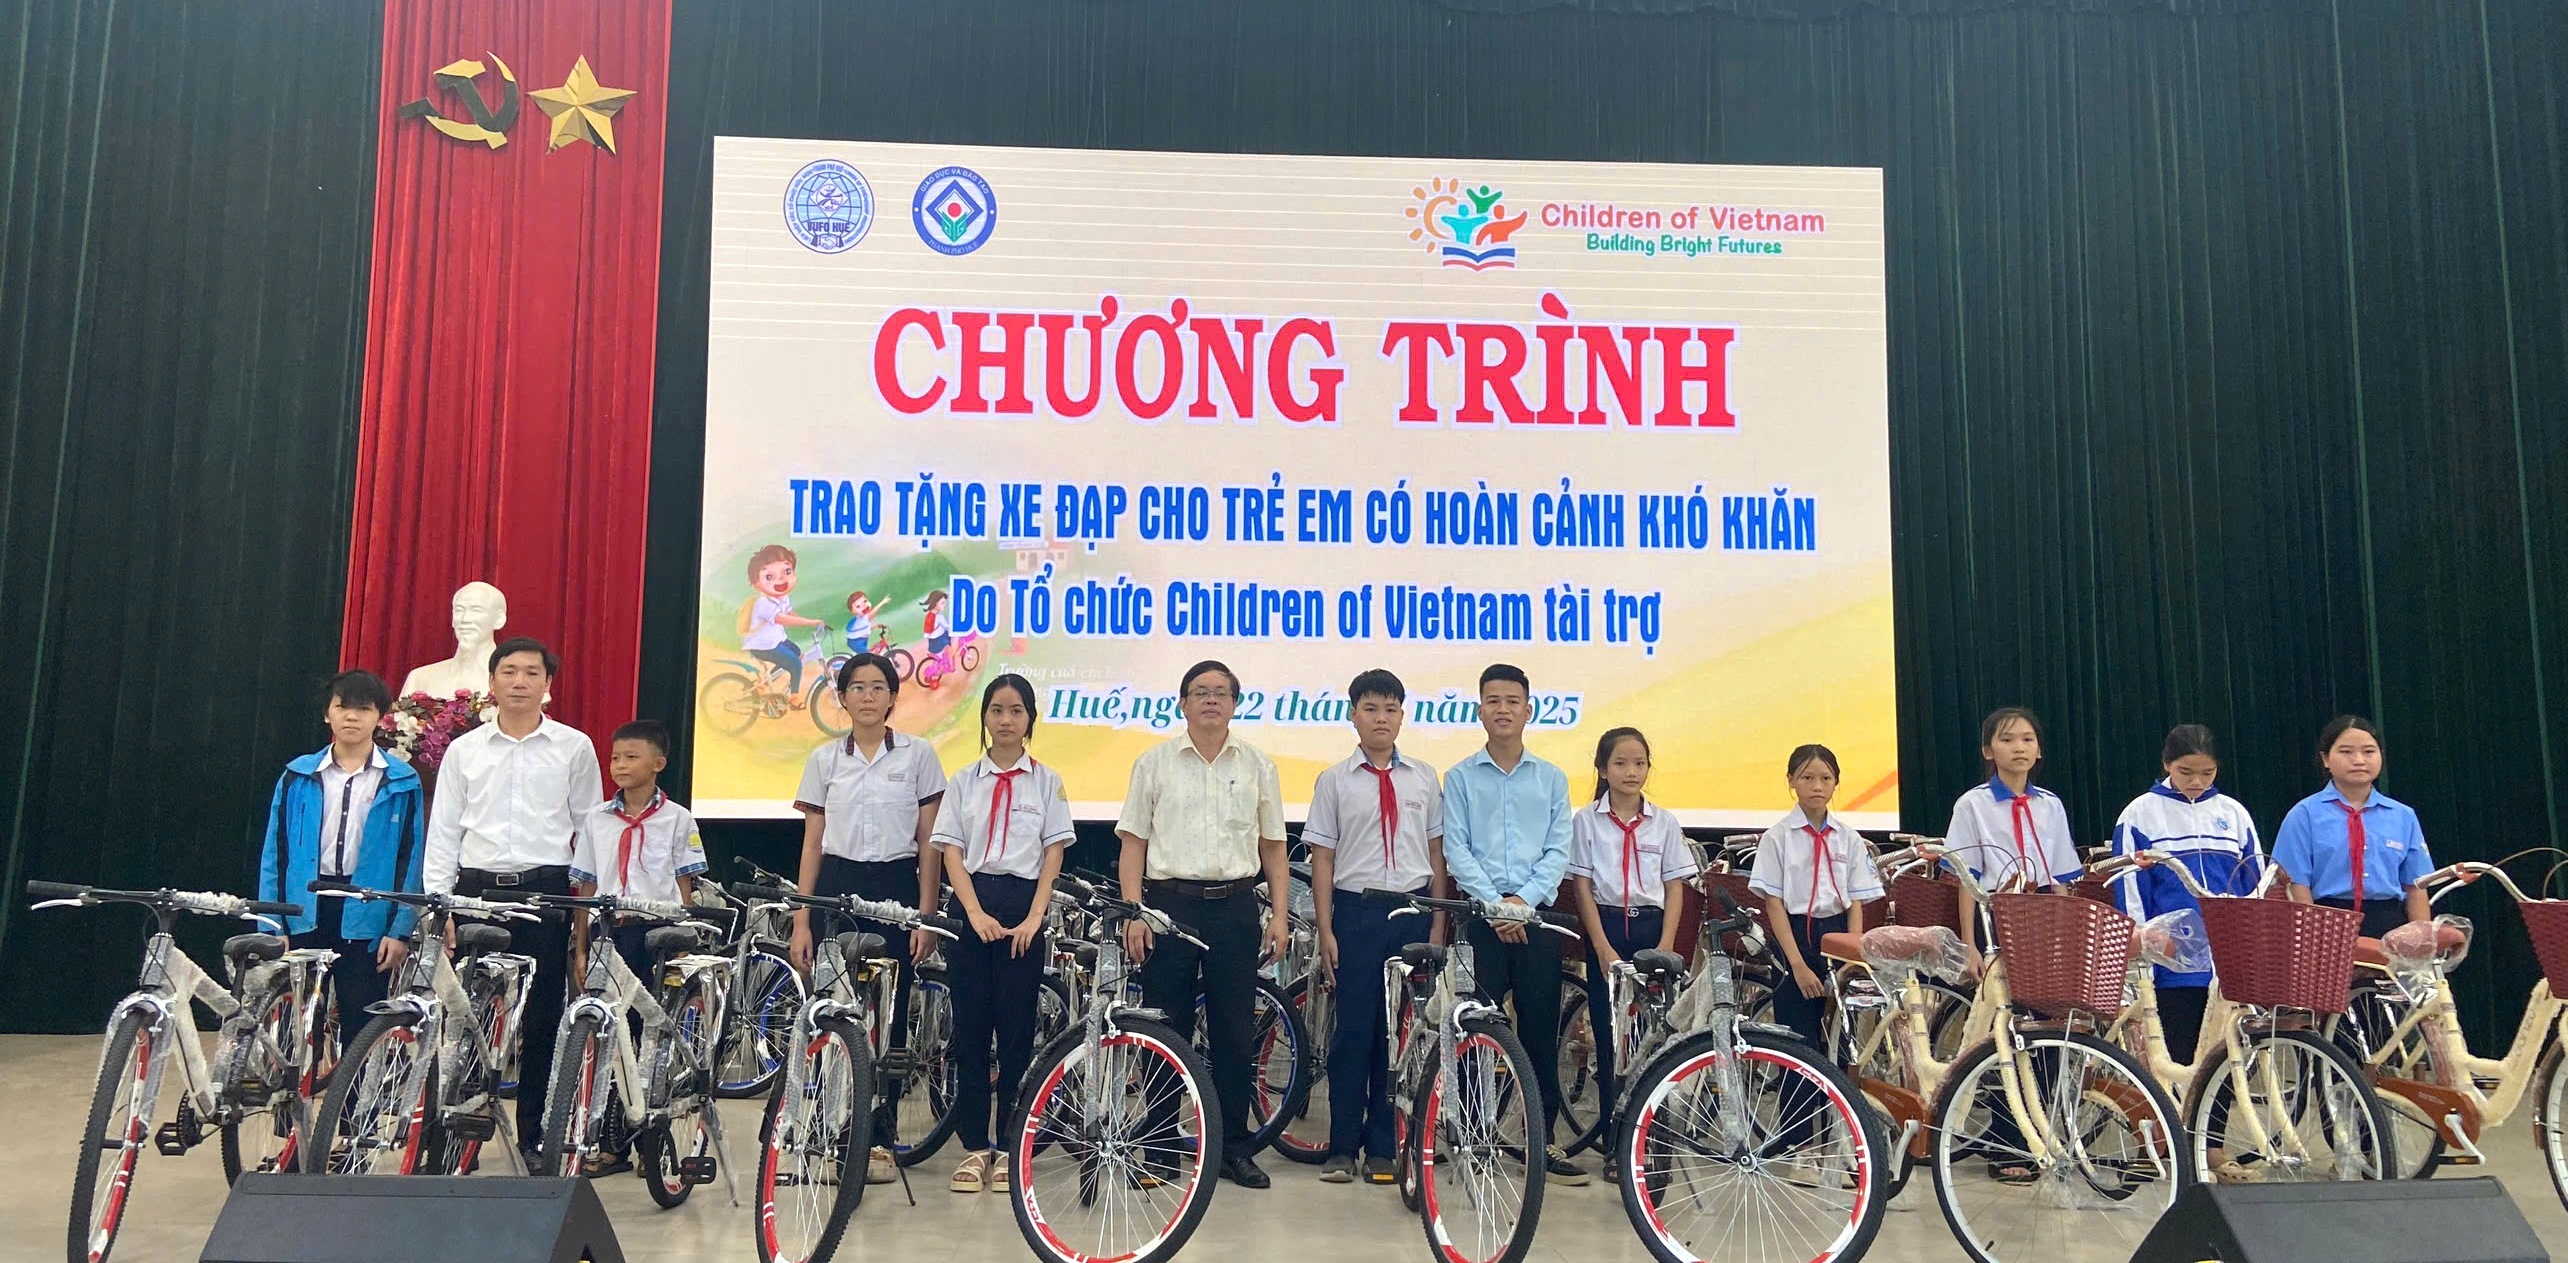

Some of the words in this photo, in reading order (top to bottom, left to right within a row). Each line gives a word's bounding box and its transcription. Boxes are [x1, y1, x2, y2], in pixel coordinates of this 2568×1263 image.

[808, 221, 830, 232] VUFO
[1542, 204, 1660, 228] Children
[1671, 207, 1698, 229] of
[1710, 208, 1824, 231] Vietnam
[1587, 234, 1655, 256] Building
[1661, 235, 1712, 256] Bright
[1718, 237, 1781, 253] Futures
[875, 296, 1344, 422] CHƯƠNG
[1383, 293, 1735, 427] TRÌNH
[791, 480, 880, 534] TRAO
[896, 473, 985, 547] TẶNG
[1000, 484, 1041, 537] XE
[1056, 485, 1126, 550] ĐẠP
[1140, 487, 1208, 540] CHO
[1223, 473, 1284, 541] TRẺ
[1299, 490, 1351, 542] EM
[1367, 481, 1410, 543] CÓ
[1427, 482, 1517, 545] HOÀN
[1533, 478, 1623, 546] CẢNH
[1640, 486, 1707, 548] KHÓ
[1723, 489, 1814, 550] KHĂN
[953, 579, 996, 632] Do
[1011, 564, 1052, 633] Tổ
[1065, 577, 1152, 634] chức
[1168, 582, 1323, 637] Children
[1339, 585, 1371, 638] of
[1386, 586, 1531, 640] Vietnam
[1545, 584, 1589, 641] tài
[1604, 589, 1660, 654] trợ
[1051, 687, 1184, 728] Huế,ng
[1274, 690, 1352, 722] thán
[1528, 696, 1579, 725] 025
